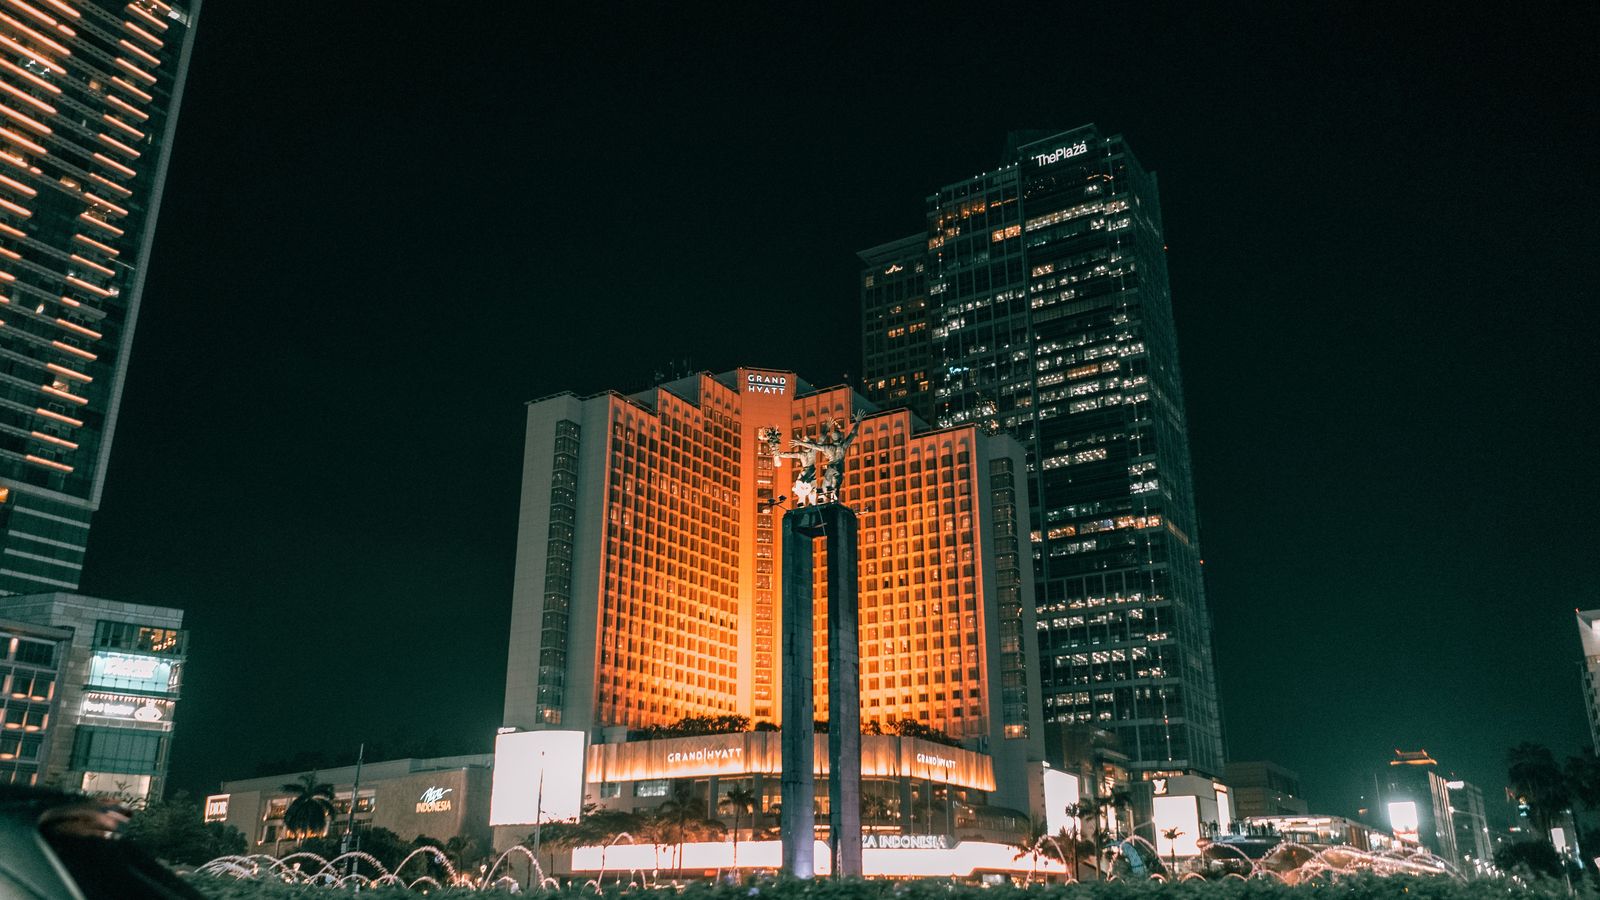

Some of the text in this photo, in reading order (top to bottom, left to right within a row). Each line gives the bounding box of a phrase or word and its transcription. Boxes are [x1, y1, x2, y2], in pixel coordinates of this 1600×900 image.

[748, 374, 786, 384] GRAND
[748, 385, 785, 395] HYATT
[667, 747, 742, 763] GRAND HYATT
[916, 753, 956, 769] GRAND HYATT
[415, 800, 452, 813] INDONESIA
